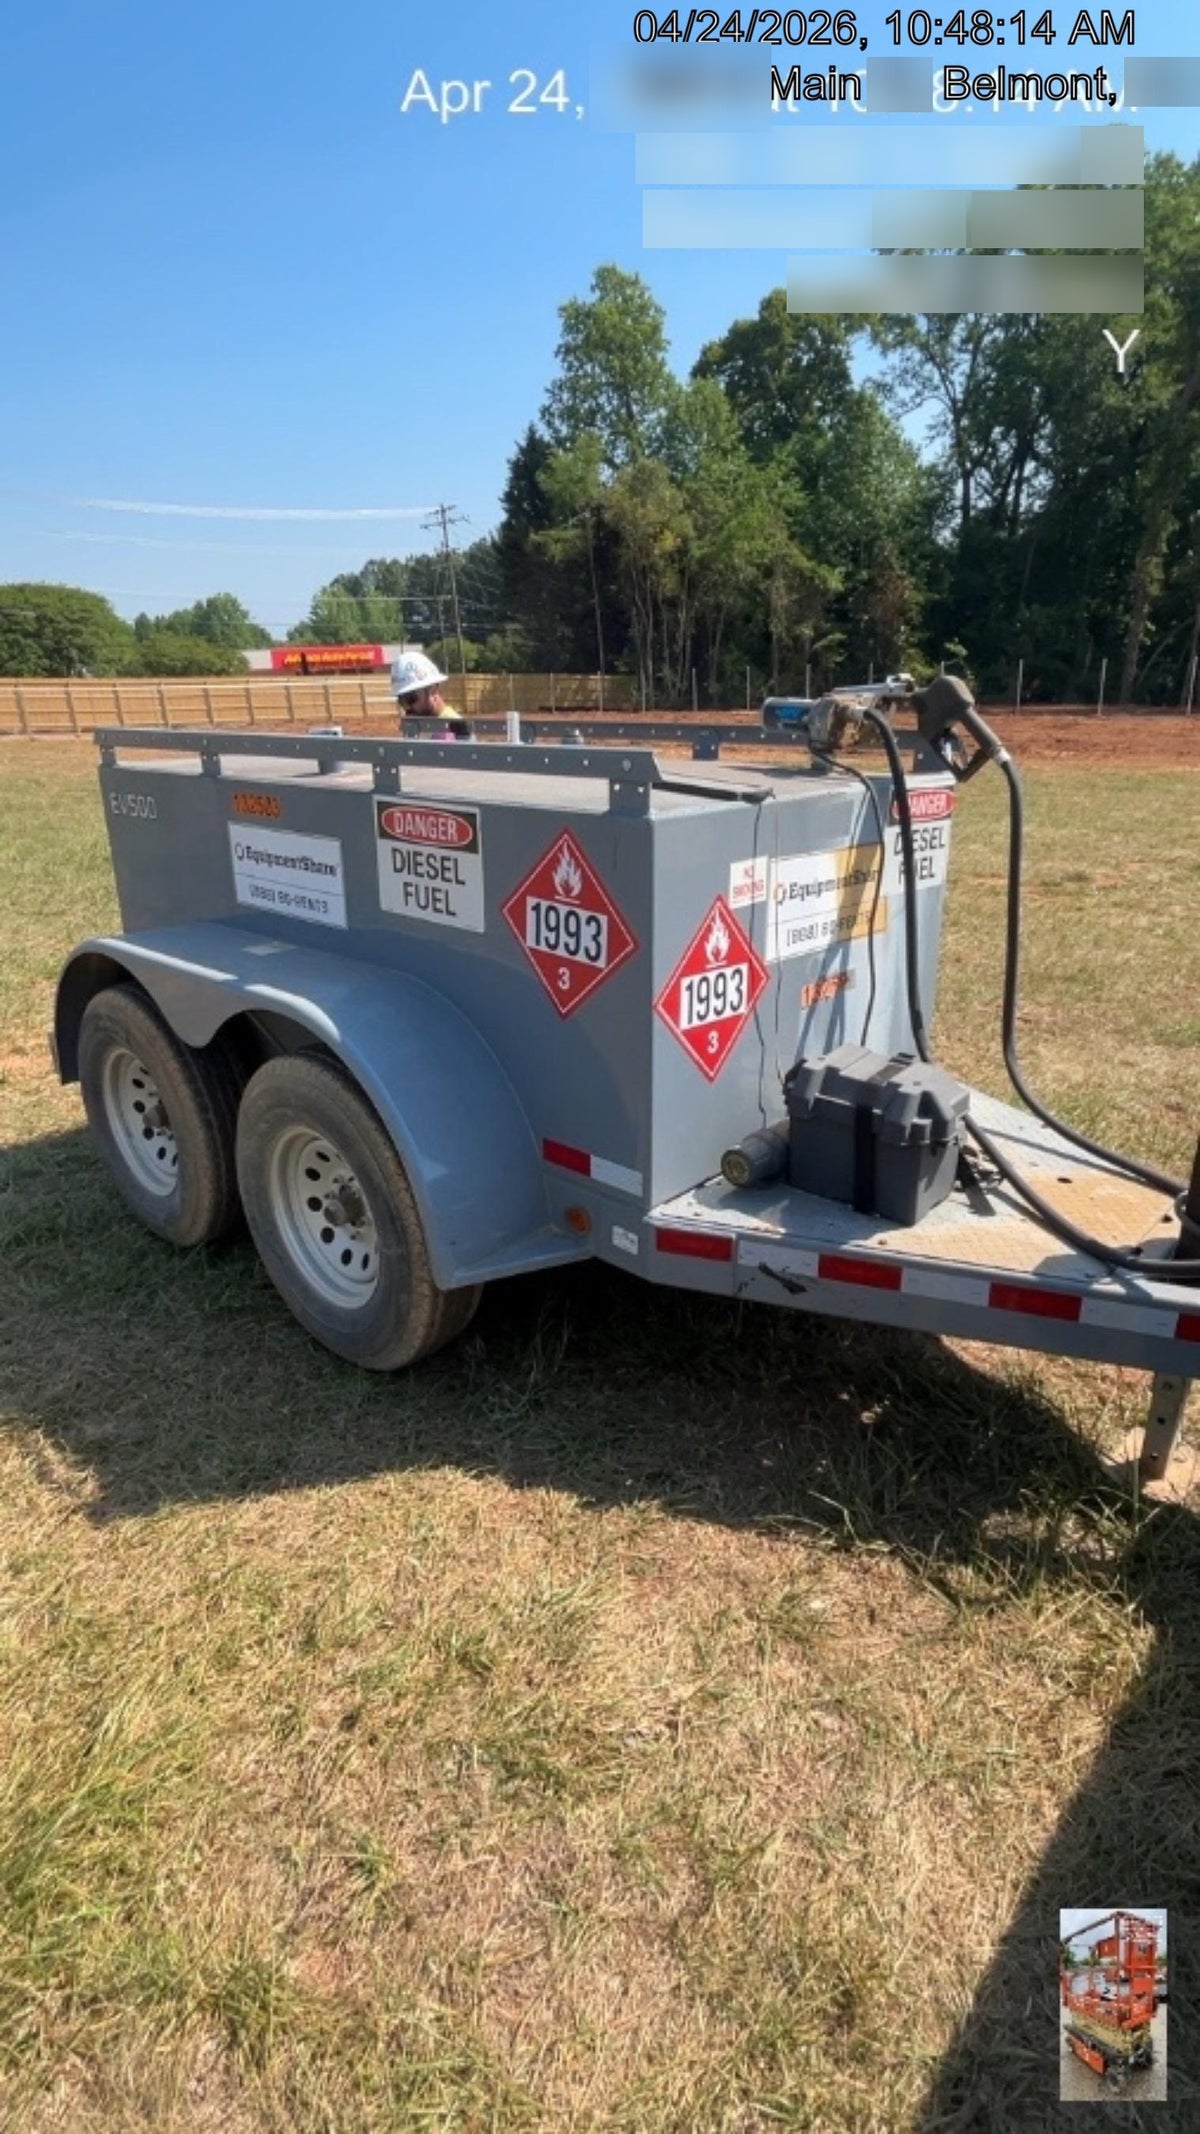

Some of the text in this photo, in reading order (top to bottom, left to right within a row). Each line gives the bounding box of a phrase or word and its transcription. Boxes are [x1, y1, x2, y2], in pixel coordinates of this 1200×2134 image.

[908, 793, 948, 818] ANGER
[392, 812, 459, 842] DANGER
[894, 827, 946, 856] DESEL
[391, 847, 466, 886] DIESEL
[402, 881, 457, 917] FUEL
[531, 901, 602, 963] 1993
[557, 966, 571, 990] 3
[685, 967, 743, 1026] 1993
[708, 1030, 720, 1054] 3
